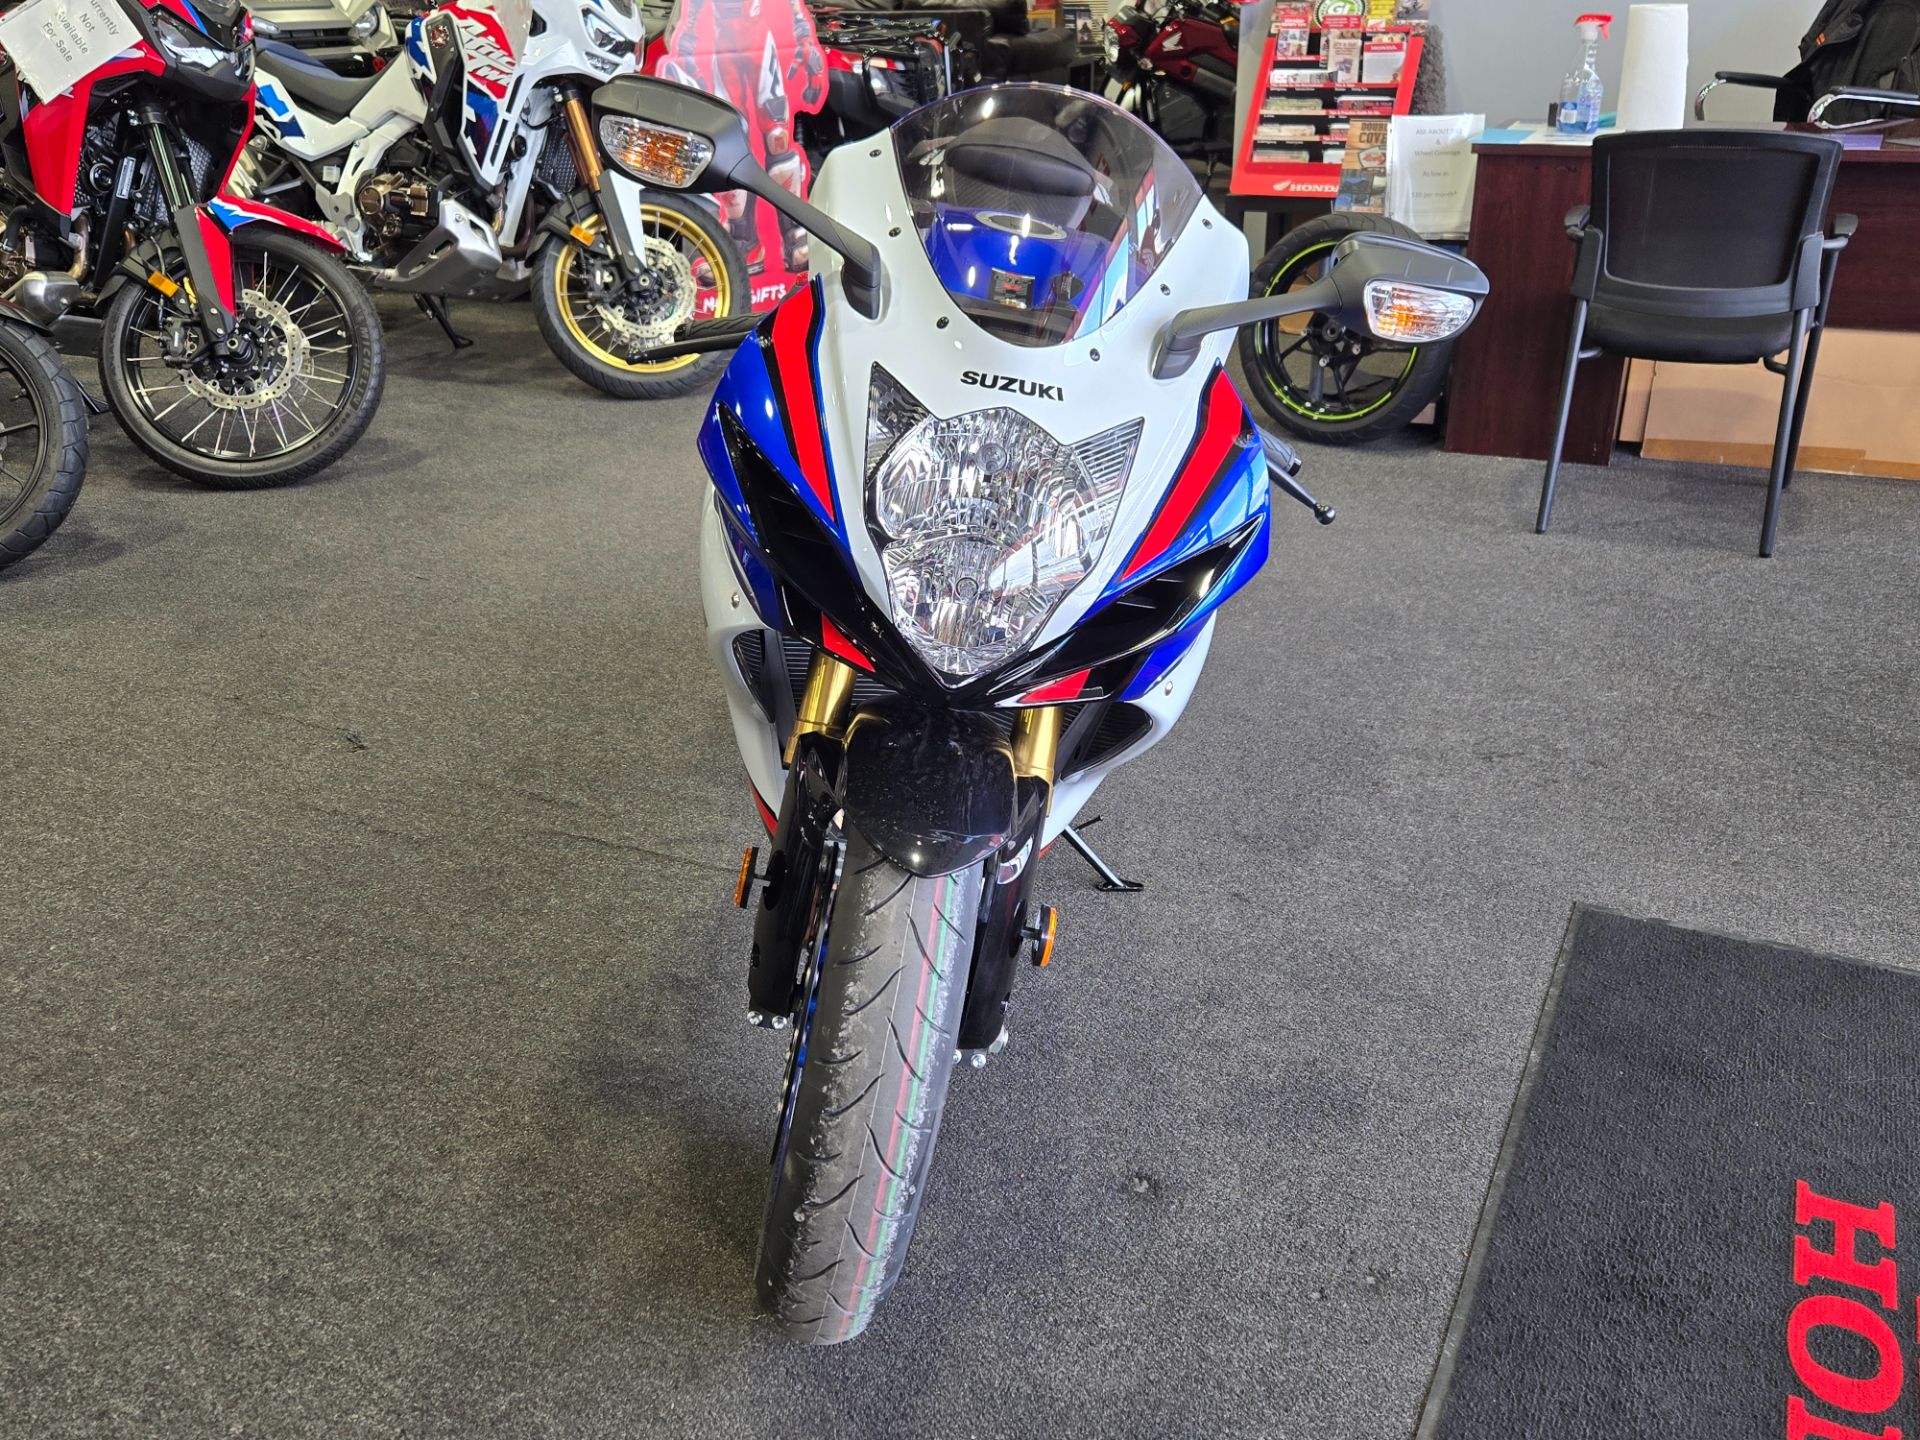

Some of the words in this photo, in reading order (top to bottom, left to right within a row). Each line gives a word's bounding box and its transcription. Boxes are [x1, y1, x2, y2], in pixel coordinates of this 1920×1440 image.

[79, 13, 96, 32] Not
[42, 22, 57, 41] For
[55, 39, 73, 62] Sale
[354, 327, 371, 406] MICHELIN
[960, 370, 1064, 402] SUZUKI
